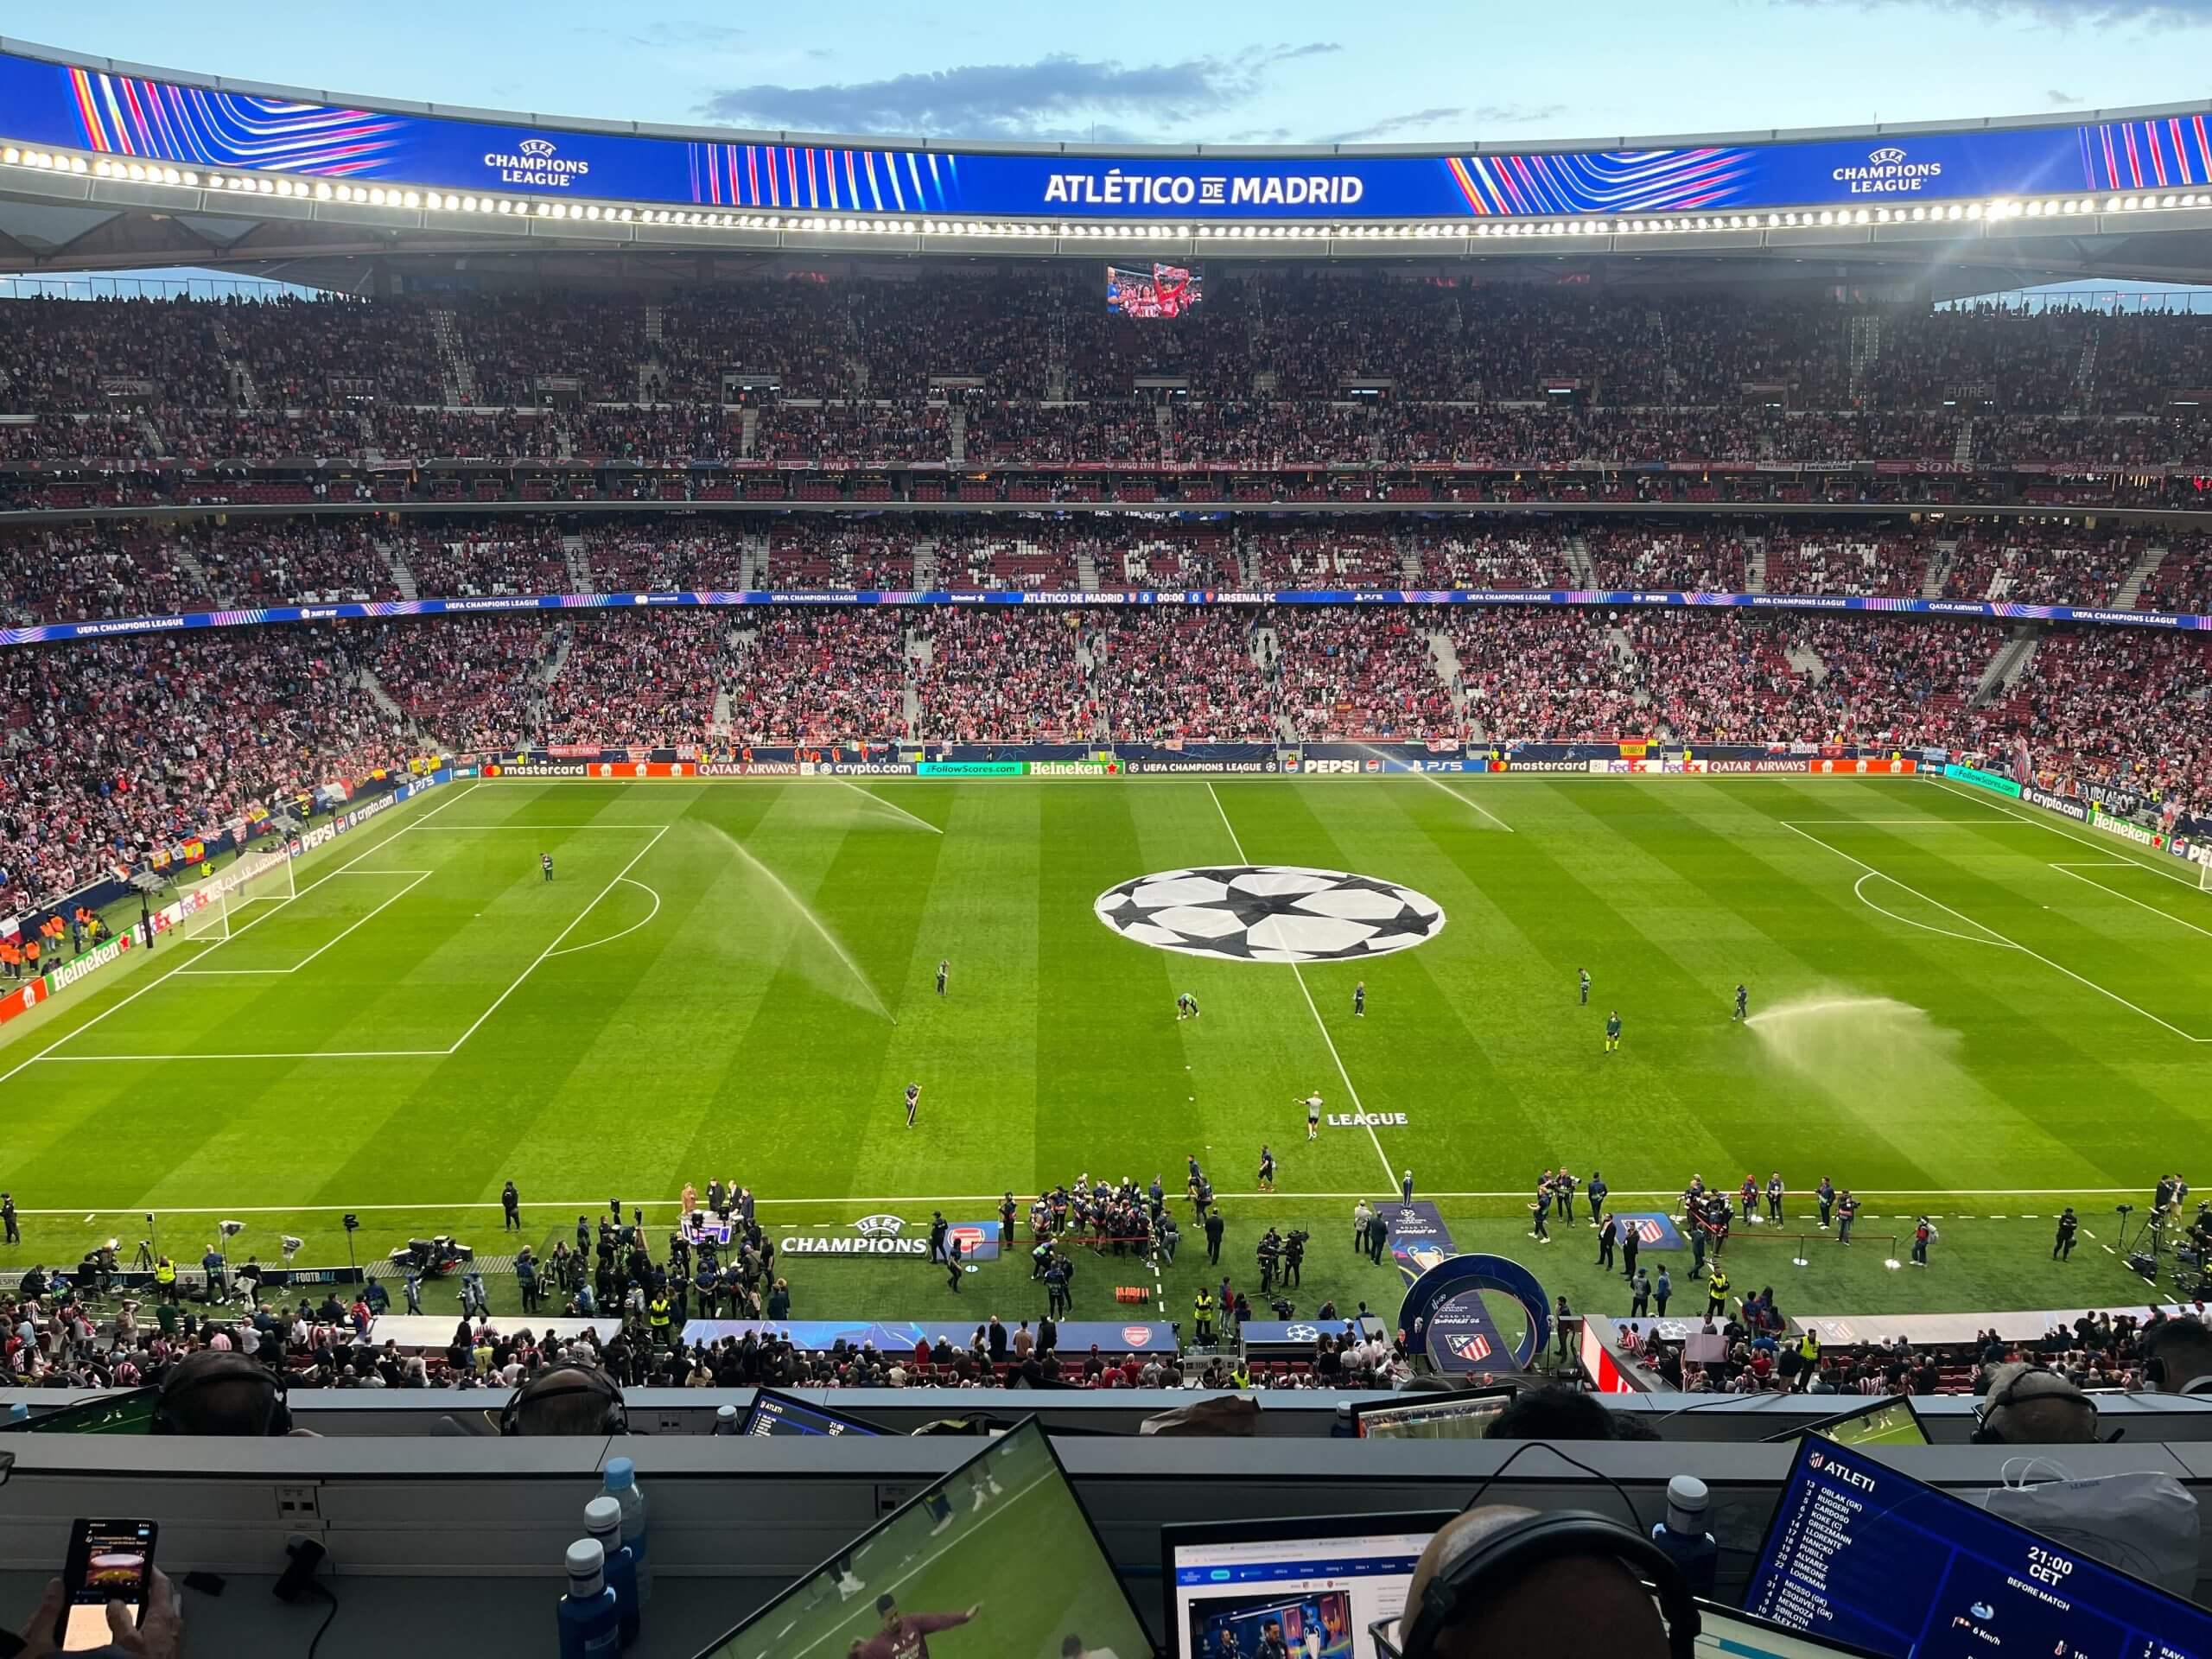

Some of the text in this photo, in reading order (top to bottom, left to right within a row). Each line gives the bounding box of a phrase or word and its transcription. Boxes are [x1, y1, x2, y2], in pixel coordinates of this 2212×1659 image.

[521, 142, 553, 156] UEFA
[1870, 150, 1903, 163] UEFA
[485, 154, 588, 174] CHAMPIONS
[1833, 162, 1941, 180] CHAMPIONS
[502, 169, 570, 187] LEAGUE
[1044, 168, 1363, 204] ATLÉTICO DE MADRID
[1851, 178, 1922, 194] LEAGUE
[823, 462, 849, 471] AVILA
[466, 600, 509, 608] CHAMPIONS
[1023, 592, 1276, 603] ATLÉTICO DE MADRID 0 00:00 0 ARSENAL FC
[77, 618, 184, 634] UEFA CHAMPIONS LEAGUE
[2094, 612, 2143, 622] CHAMPIONS
[2145, 615, 2177, 625] LEAGUE
[504, 763, 584, 775] mastercard
[699, 763, 797, 776] QATAR AIRWAYS
[836, 762, 912, 776] crypto.com
[1030, 761, 1103, 775] Heineken
[1170, 763, 1224, 772] CHAMPIONS
[1226, 763, 1262, 772] LEAGUE
[1305, 761, 1359, 773] PEPSI
[1427, 761, 1463, 771] PS5
[1510, 761, 1587, 772] mastercard
[1607, 760, 1646, 772] FedEx
[1662, 760, 1701, 772] FedEx
[1711, 762, 1806, 772] QATAR AIRWAYS
[357, 794, 394, 821] crypto.com
[2032, 790, 2083, 819] crypto.com
[2092, 811, 2151, 845] Heineken
[302, 826, 335, 851] PEPSI
[51, 942, 119, 991] Heineken
[1327, 1112, 1408, 1125] LEAGUE
[857, 1217, 900, 1232] UEFA
[781, 1237, 927, 1254] CHAMPIONS
[766, 1402, 783, 1414] ATLETI
[1824, 1461, 1875, 1492] ATLETI
[1806, 1479, 1863, 1513] 13 OBLAK (GK)
[1817, 1494, 1850, 1515] RUGGERI
[1811, 1510, 1832, 1525] KOKE
[1831, 1520, 1842, 1532] (C)
[1814, 1503, 1850, 1524] CARDOSO
[1788, 1528, 1834, 1555] 17 HANCKO
[1791, 1520, 1843, 1550] 14 LLORENTE
[1808, 1519, 1853, 1546] GRIEZMANN
[1784, 1535, 1825, 1561] 18 PUBILL
[1777, 1552, 1827, 1581] 20 SIMEONE
[1782, 1543, 1829, 1573] 19 ALVAREZ
[2027, 1546, 2073, 1575] 21:00
[1774, 1560, 1827, 1591] 22 LOOKMAN
[2029, 1563, 2063, 1586] CET
[1766, 1580, 1834, 1621] 31 ESQUIVEL (GK)
[1784, 1580, 1811, 1598] MUSSO
[1811, 1594, 1827, 1607] (GK)
[2007, 1576, 2070, 1611] BEFORE MATCH
[1758, 1605, 1767, 1614] 10
[1775, 1605, 1809, 1627] SØRLOTH
[1777, 1596, 1814, 1620] MENDOZA
[1973, 1626, 2001, 1646] 6 Km/h
[2144, 1649, 2151, 1659] 2
